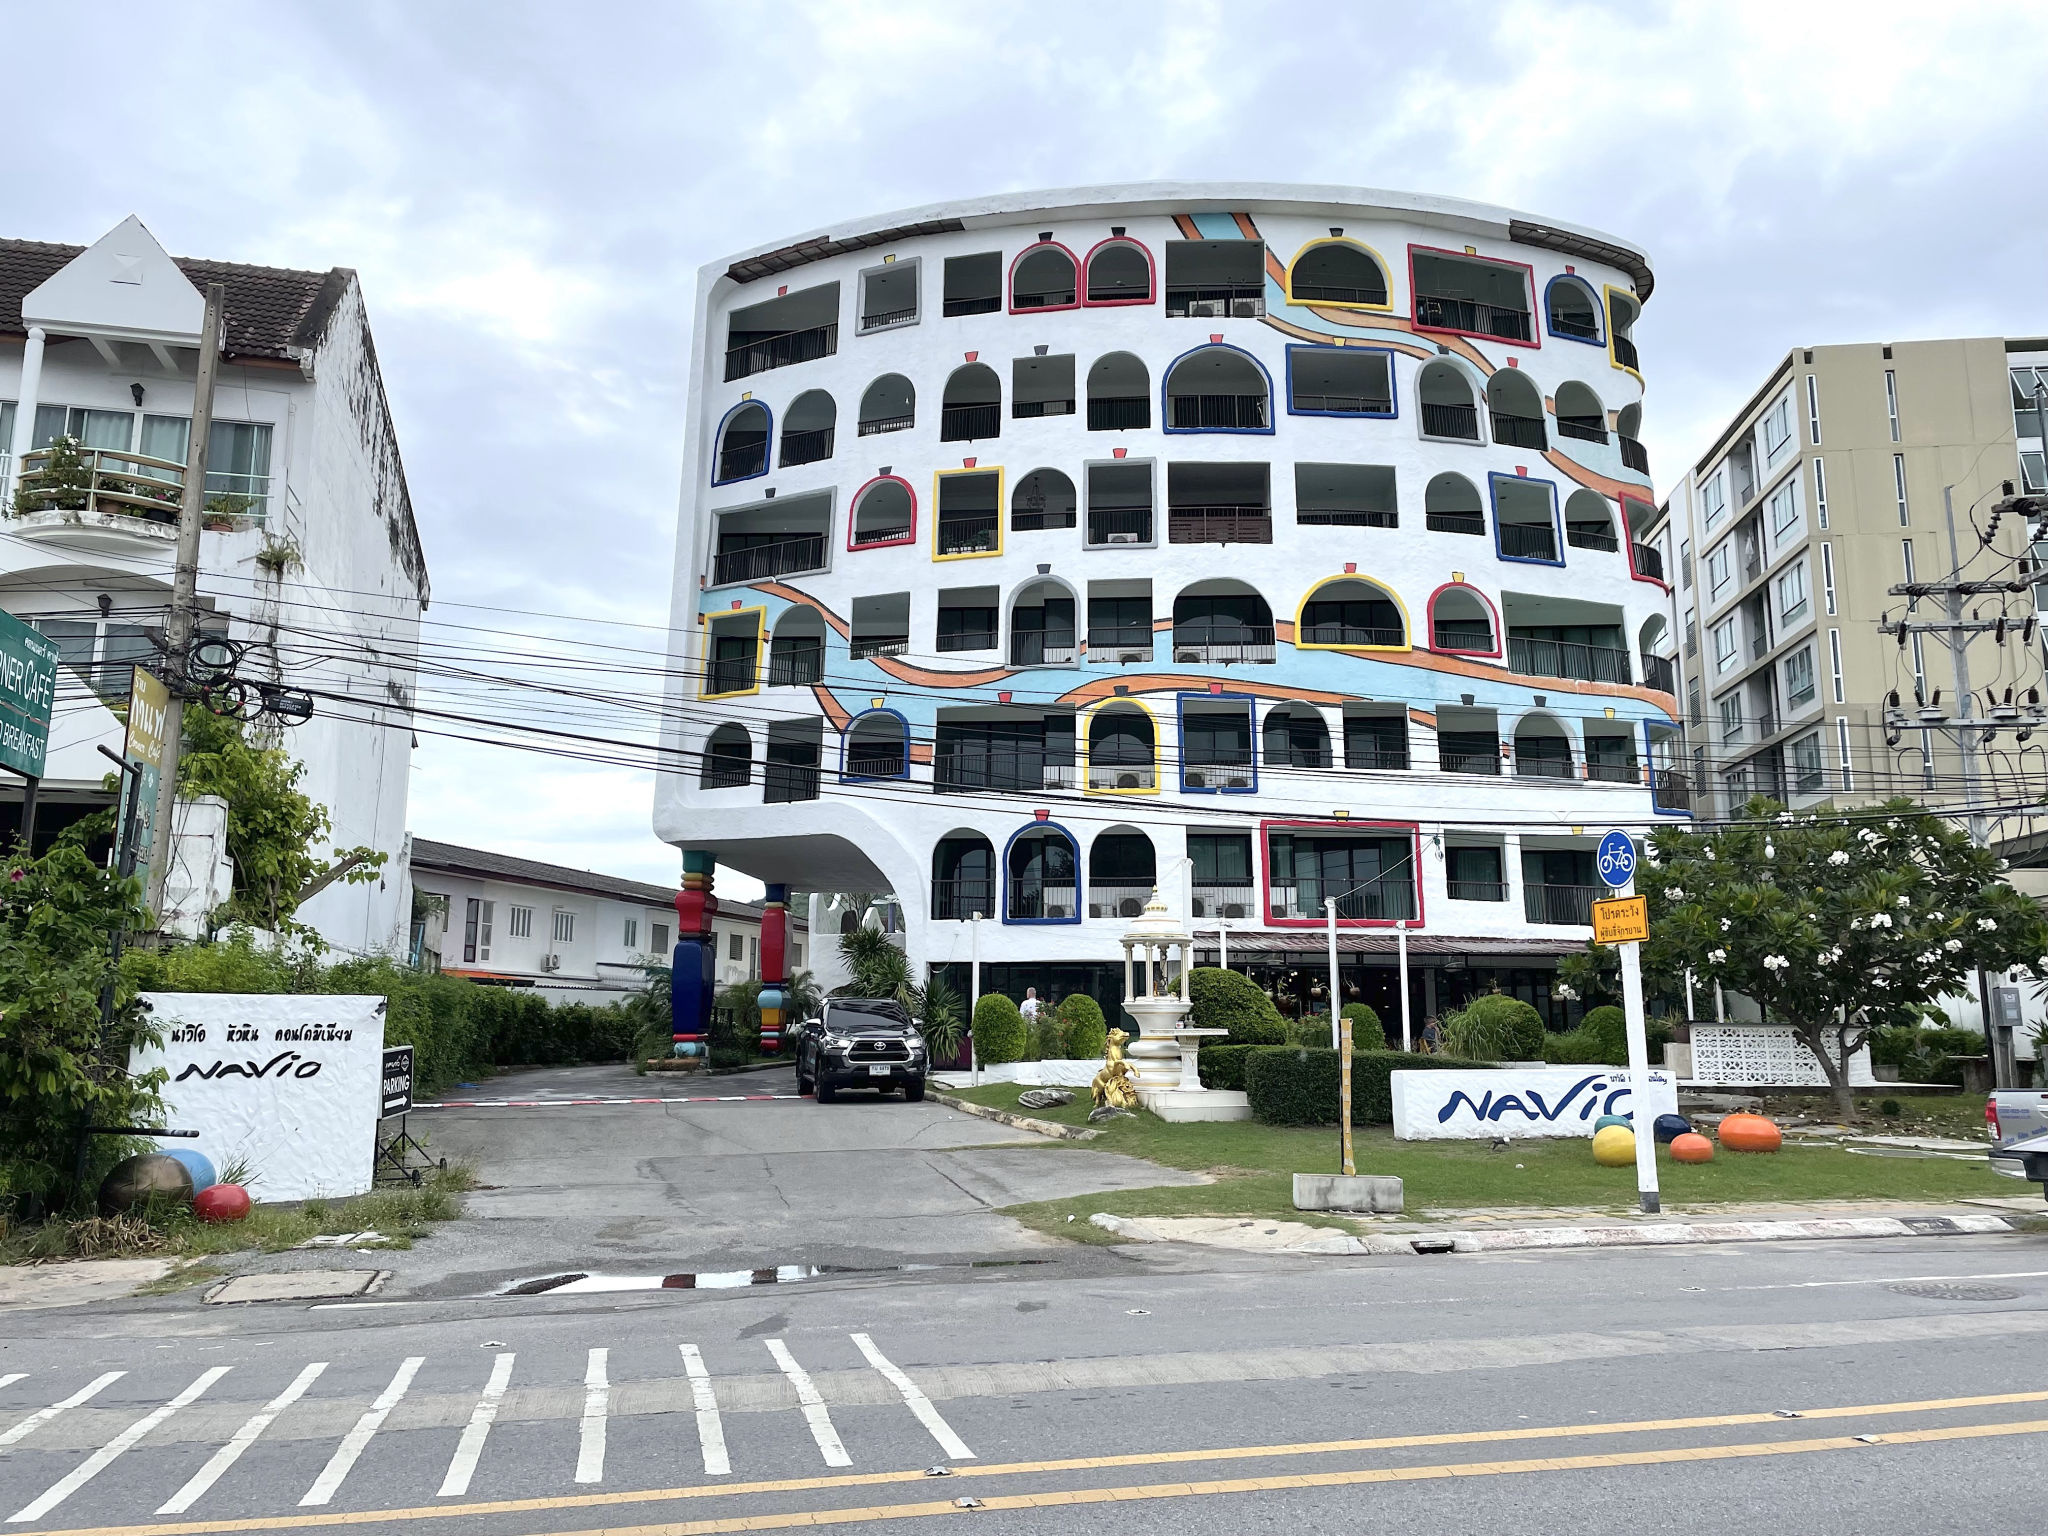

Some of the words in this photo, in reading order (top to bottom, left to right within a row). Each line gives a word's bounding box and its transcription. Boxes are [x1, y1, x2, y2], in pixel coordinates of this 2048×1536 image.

[24, 660, 52, 709] CAFÉ
[130, 693, 168, 742] กาแฟ
[2, 722, 45, 760] BREAKFAST
[1600, 904, 1639, 920] โปรดระวัง
[171, 1023, 206, 1042] นาวิโอ
[227, 1023, 260, 1042] หัวหิน
[274, 1022, 353, 1042] คอนโดมิเนียม
[383, 1074, 410, 1096] PARKING
